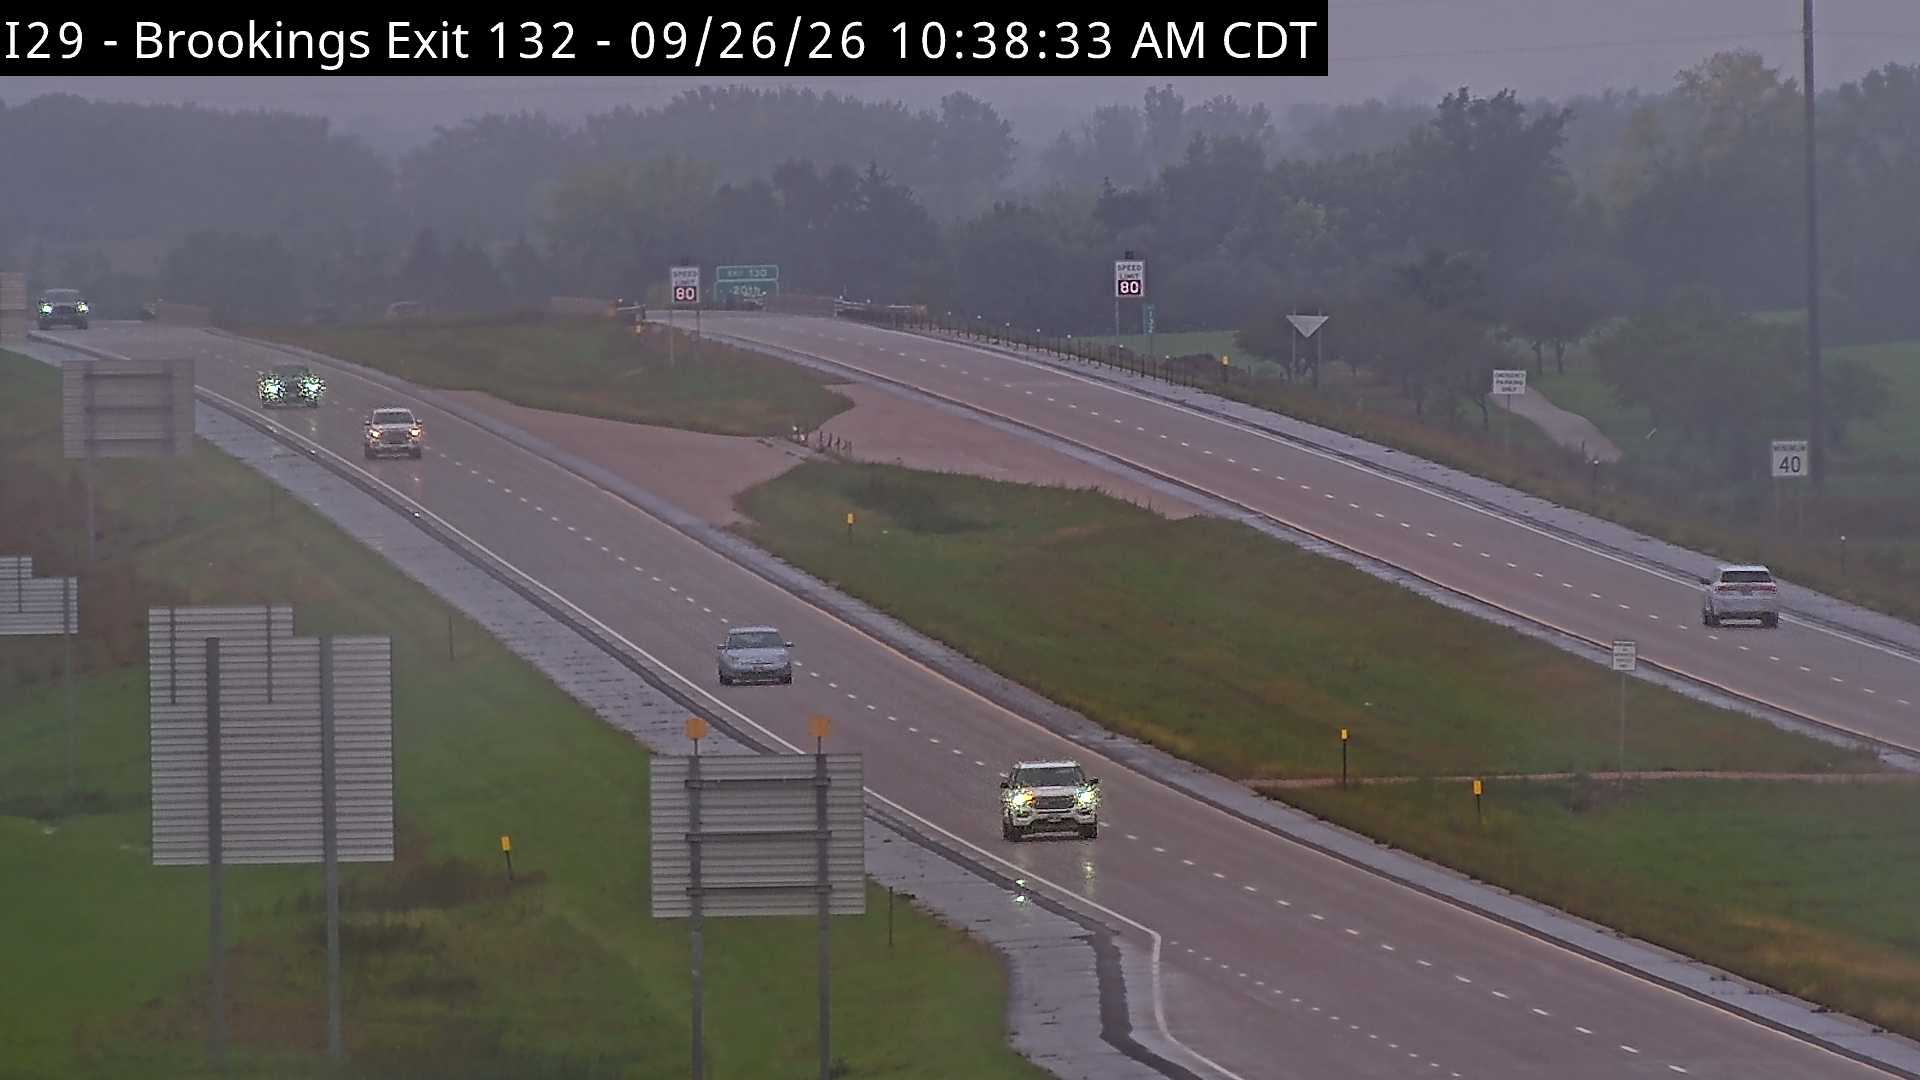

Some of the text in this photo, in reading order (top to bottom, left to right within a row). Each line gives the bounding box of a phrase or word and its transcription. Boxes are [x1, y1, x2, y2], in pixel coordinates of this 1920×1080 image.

[1117, 264, 1143, 272] SPEED
[673, 270, 698, 279] SPEED
[1120, 272, 1140, 280] LIMIT
[1120, 281, 1139, 294] 80
[676, 287, 695, 301] 80
[1779, 455, 1801, 473] 40
